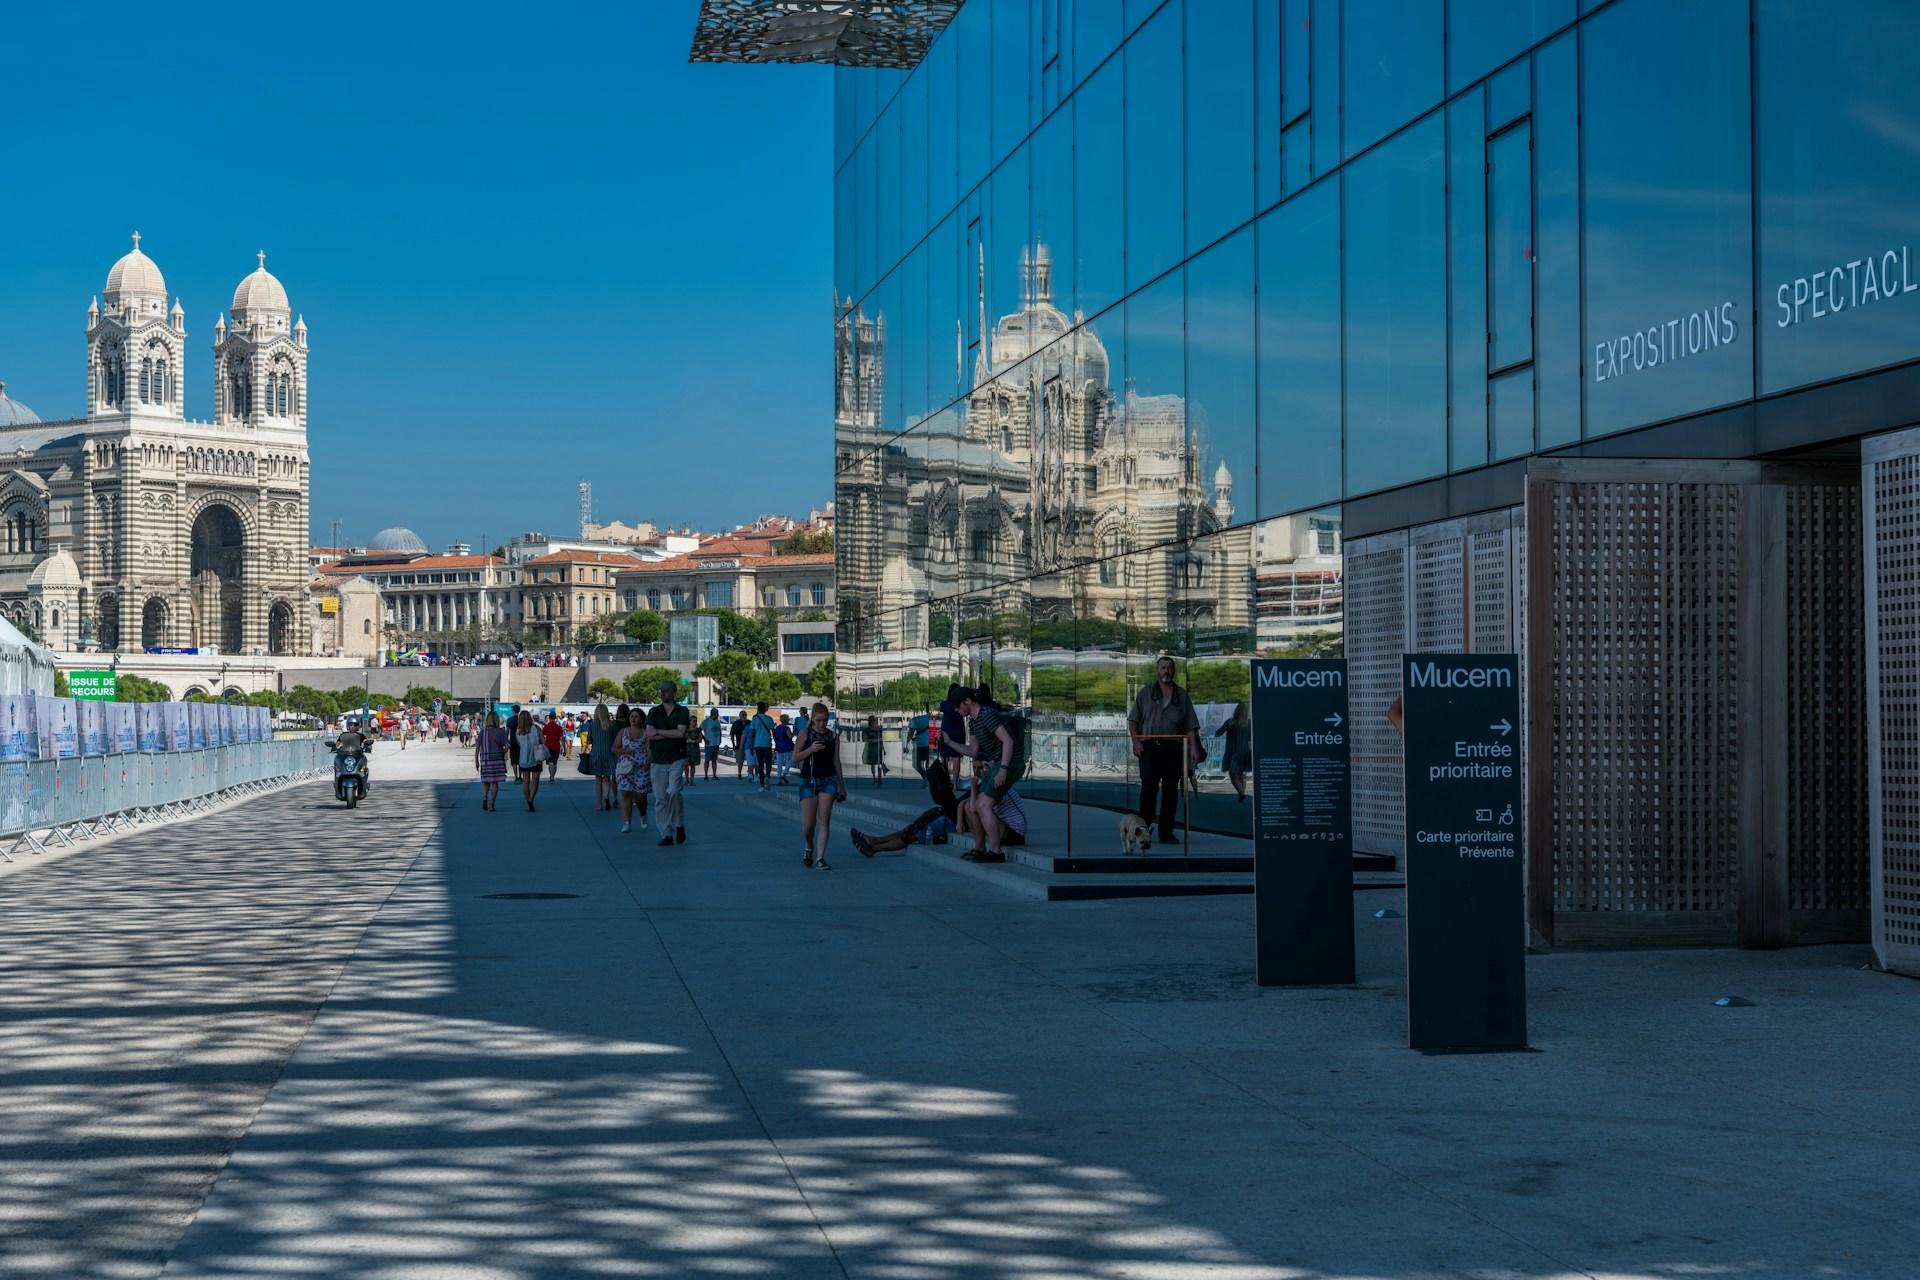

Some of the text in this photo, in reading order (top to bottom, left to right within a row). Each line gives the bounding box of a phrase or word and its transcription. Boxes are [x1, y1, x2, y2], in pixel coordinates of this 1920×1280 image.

[1595, 245, 1919, 383] EXPOSITIONS SPECTACL
[71, 677, 115, 687] ISSUE DE
[1256, 665, 1342, 688] Mucem
[1411, 661, 1512, 689] Mucem
[71, 687, 115, 696] SECOURS
[1294, 730, 1343, 745] Entrée
[1454, 740, 1512, 758] Entrée
[1429, 762, 1513, 782] prioritaire
[1416, 829, 1514, 844] Carte prioritaire
[1459, 845, 1514, 858] Prévente
